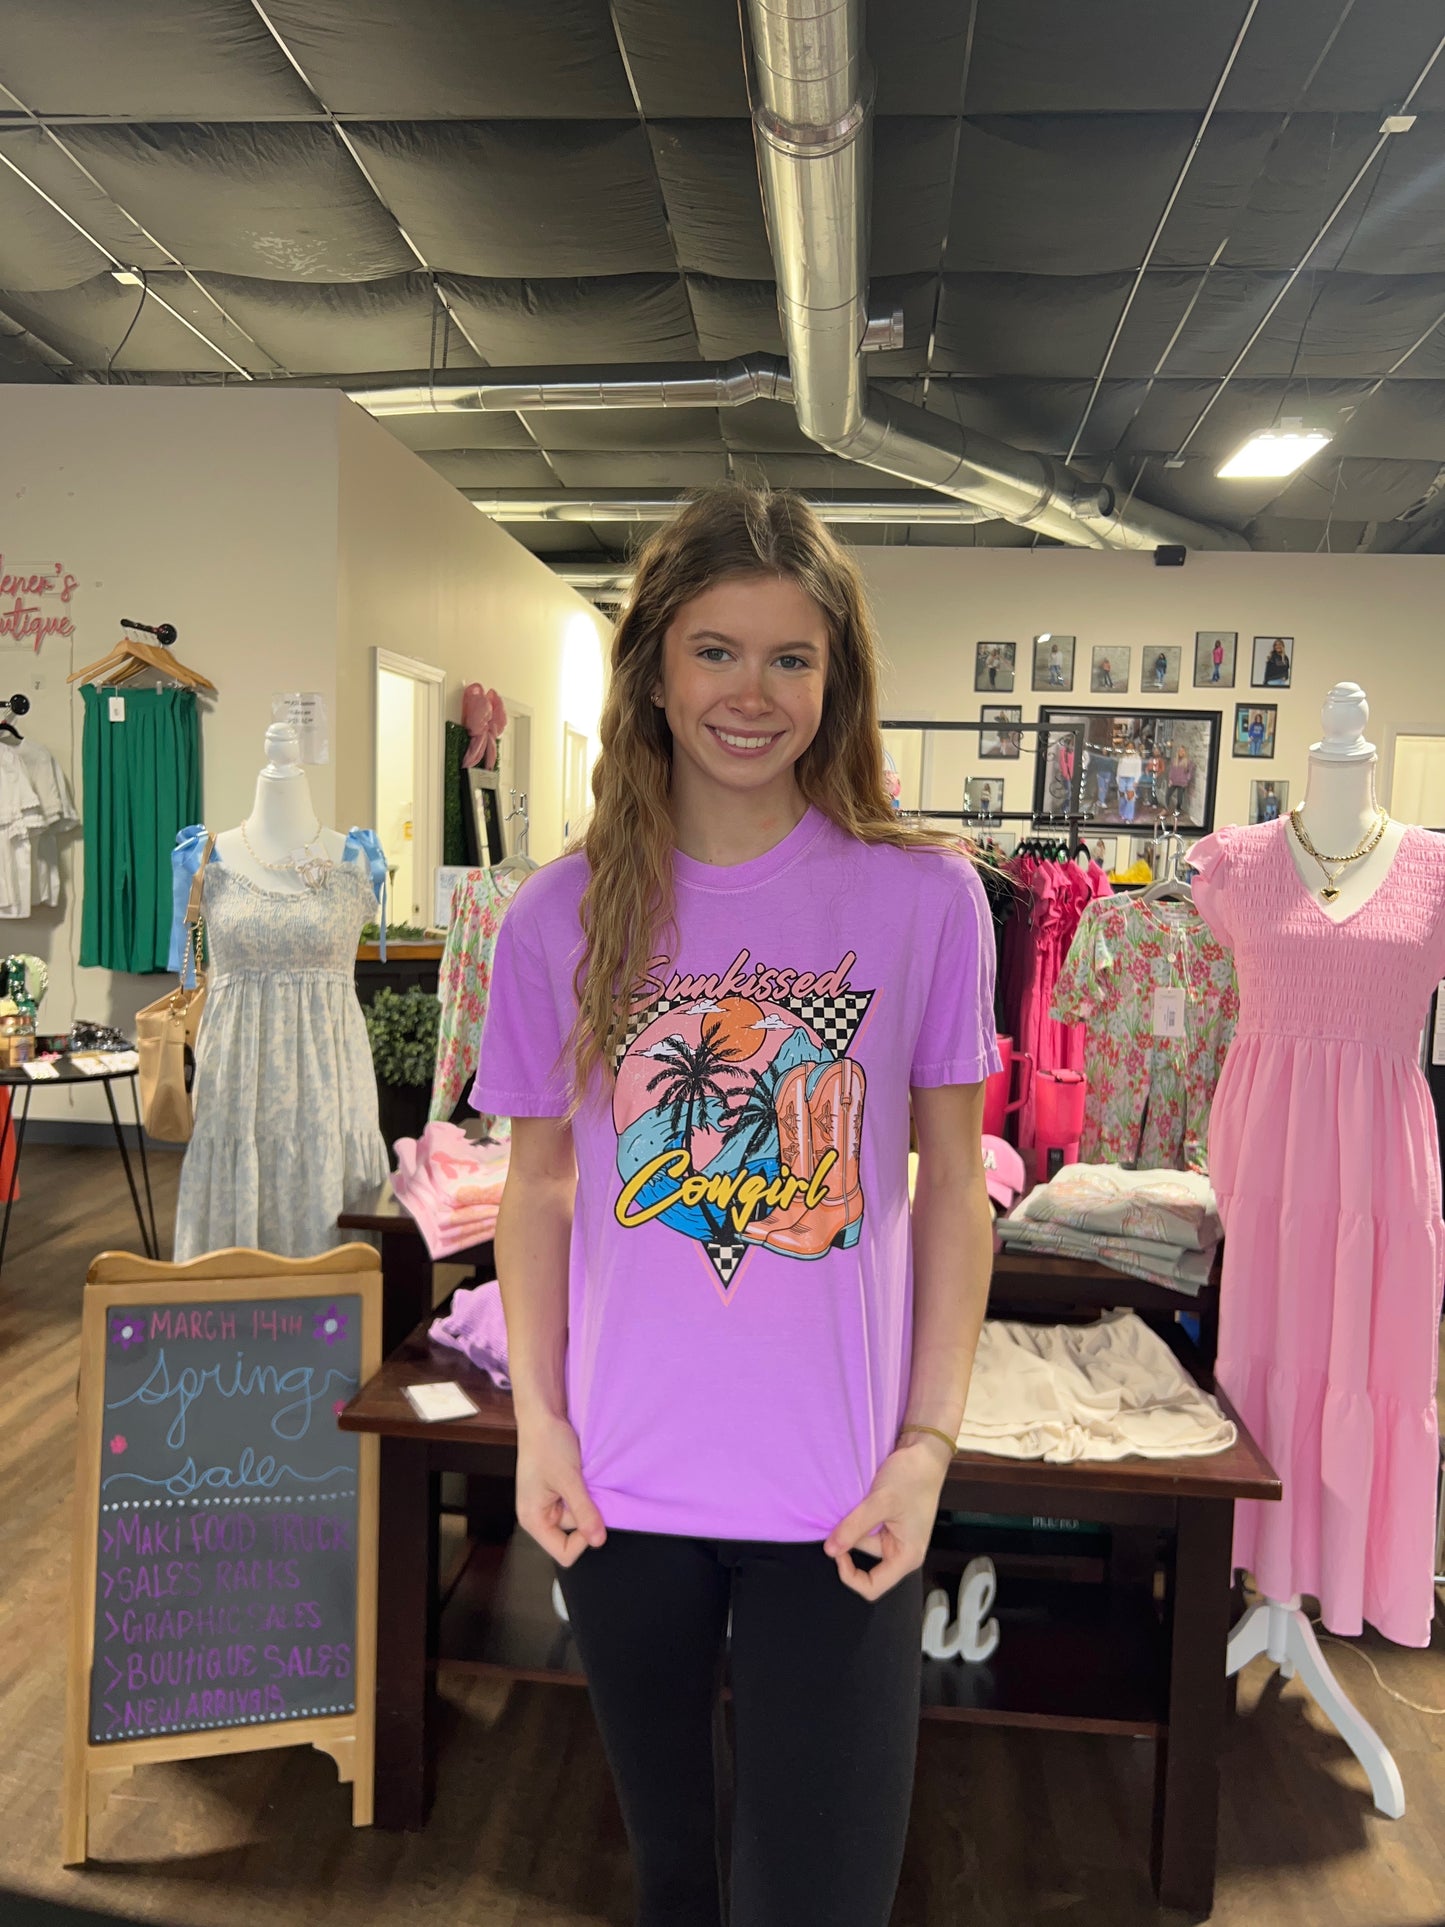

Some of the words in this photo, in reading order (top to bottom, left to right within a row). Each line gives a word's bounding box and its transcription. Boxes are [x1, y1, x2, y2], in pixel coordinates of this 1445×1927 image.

[0, 554, 79, 602] ener's
[613, 948, 857, 1016] Sunkissed
[614, 1148, 839, 1233] Cowgirl
[150, 1310, 236, 1341] MARCH
[190, 1512, 256, 1554] FOOD
[262, 1512, 351, 1553] TRUCK
[118, 1561, 203, 1603] SALES
[216, 1559, 301, 1596] RACKS
[263, 1644, 351, 1679] SALES
[124, 1698, 180, 1727] NEW
